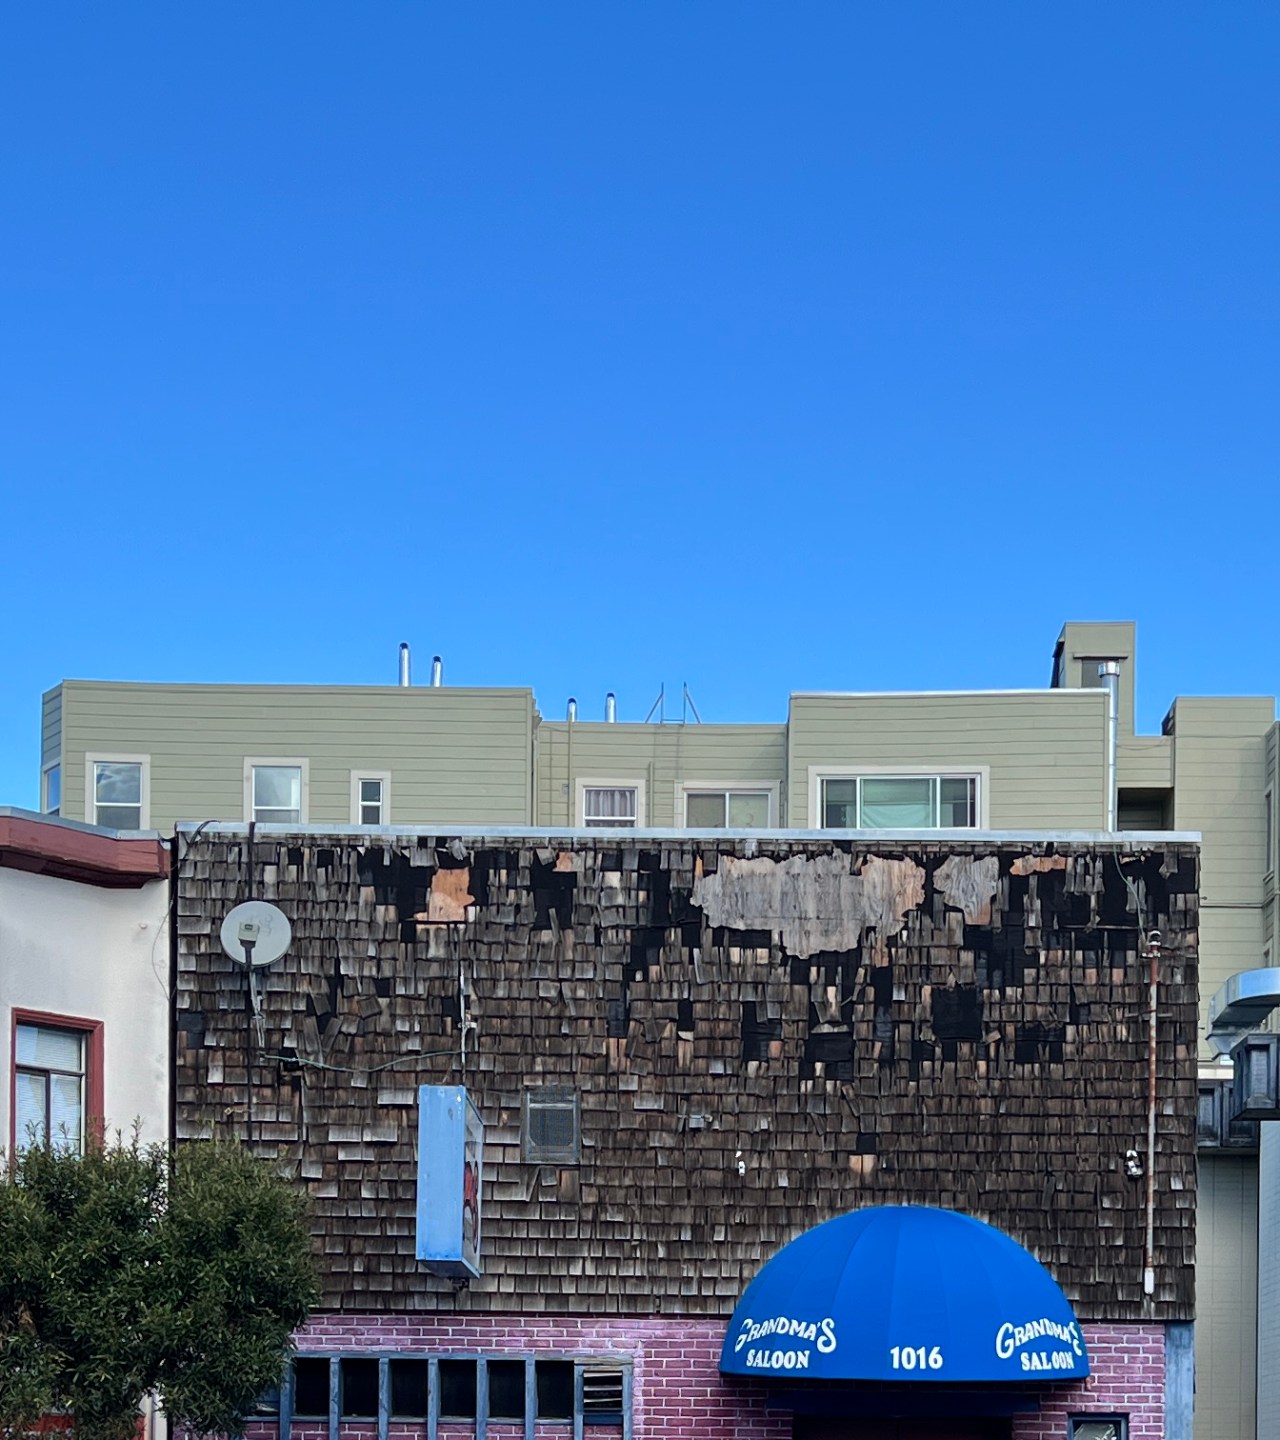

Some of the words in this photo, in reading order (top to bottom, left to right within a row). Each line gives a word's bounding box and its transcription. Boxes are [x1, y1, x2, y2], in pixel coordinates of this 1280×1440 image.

[735, 1316, 837, 1353] GRANDMA'S
[995, 1317, 1083, 1359] GRANDMA'S
[746, 1349, 810, 1369] SALOON
[889, 1346, 944, 1370] 1016
[1020, 1351, 1075, 1372] SALOON
